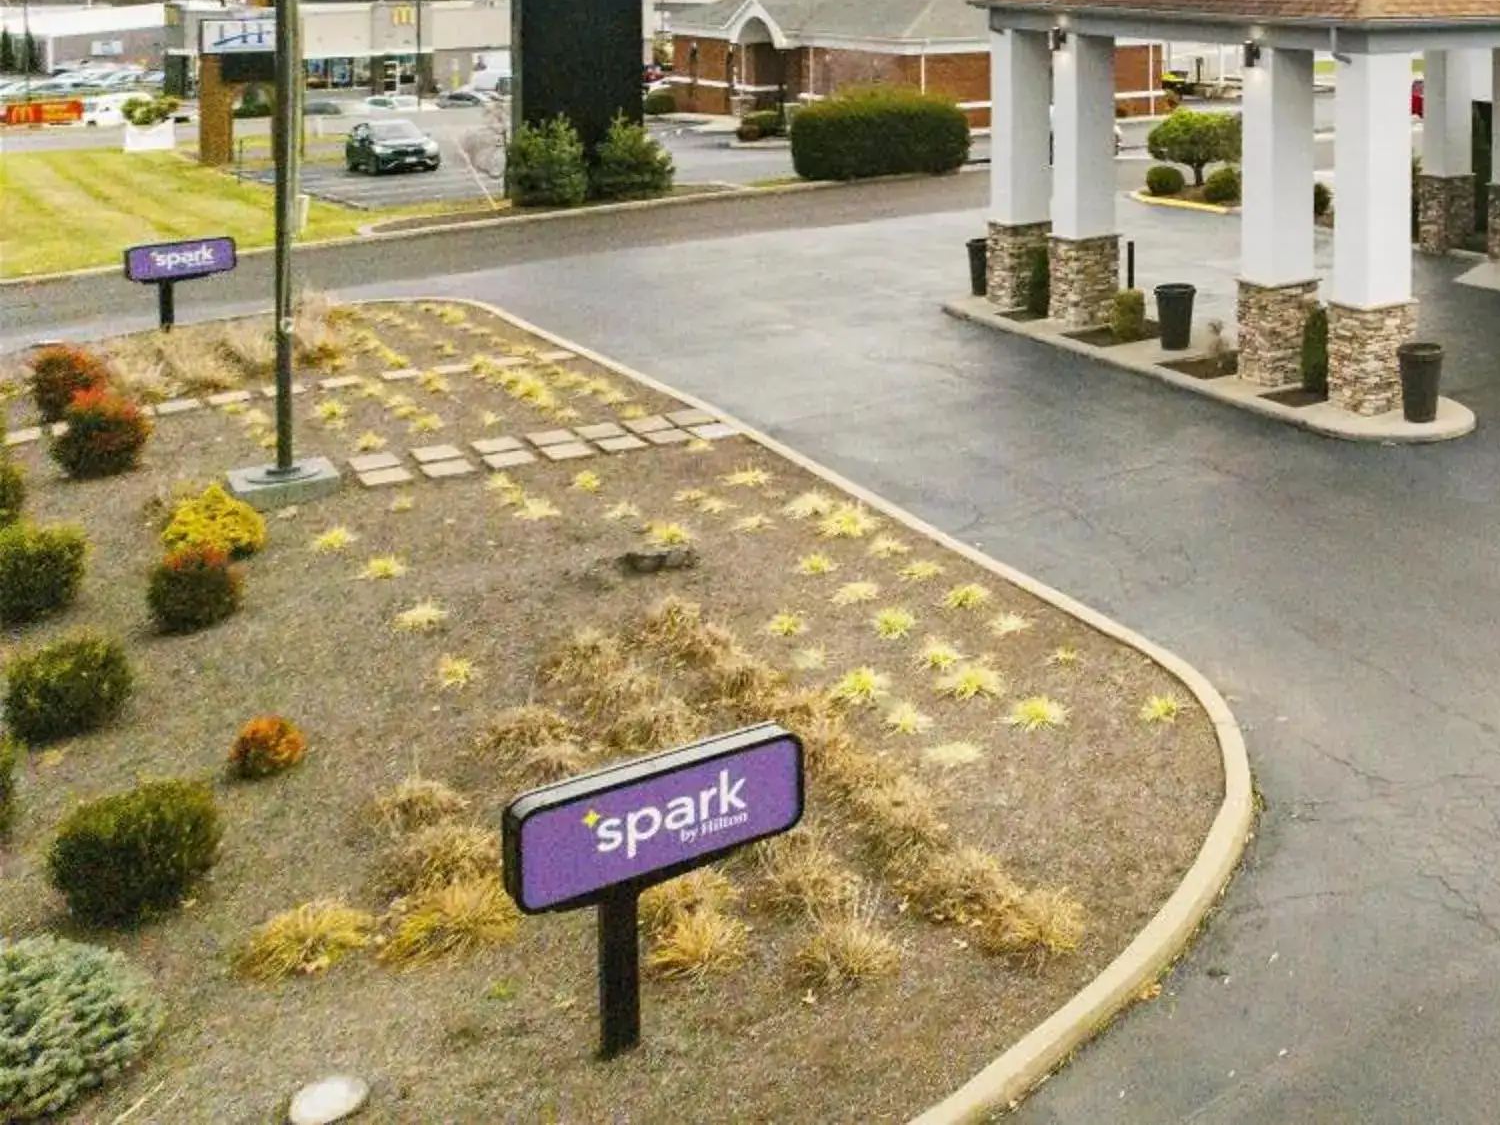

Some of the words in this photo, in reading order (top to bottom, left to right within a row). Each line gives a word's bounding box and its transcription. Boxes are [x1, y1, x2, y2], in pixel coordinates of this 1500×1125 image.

[154, 244, 214, 270] spark
[597, 769, 746, 858] spark
[680, 827, 697, 843] by
[701, 811, 748, 835] Hilton
